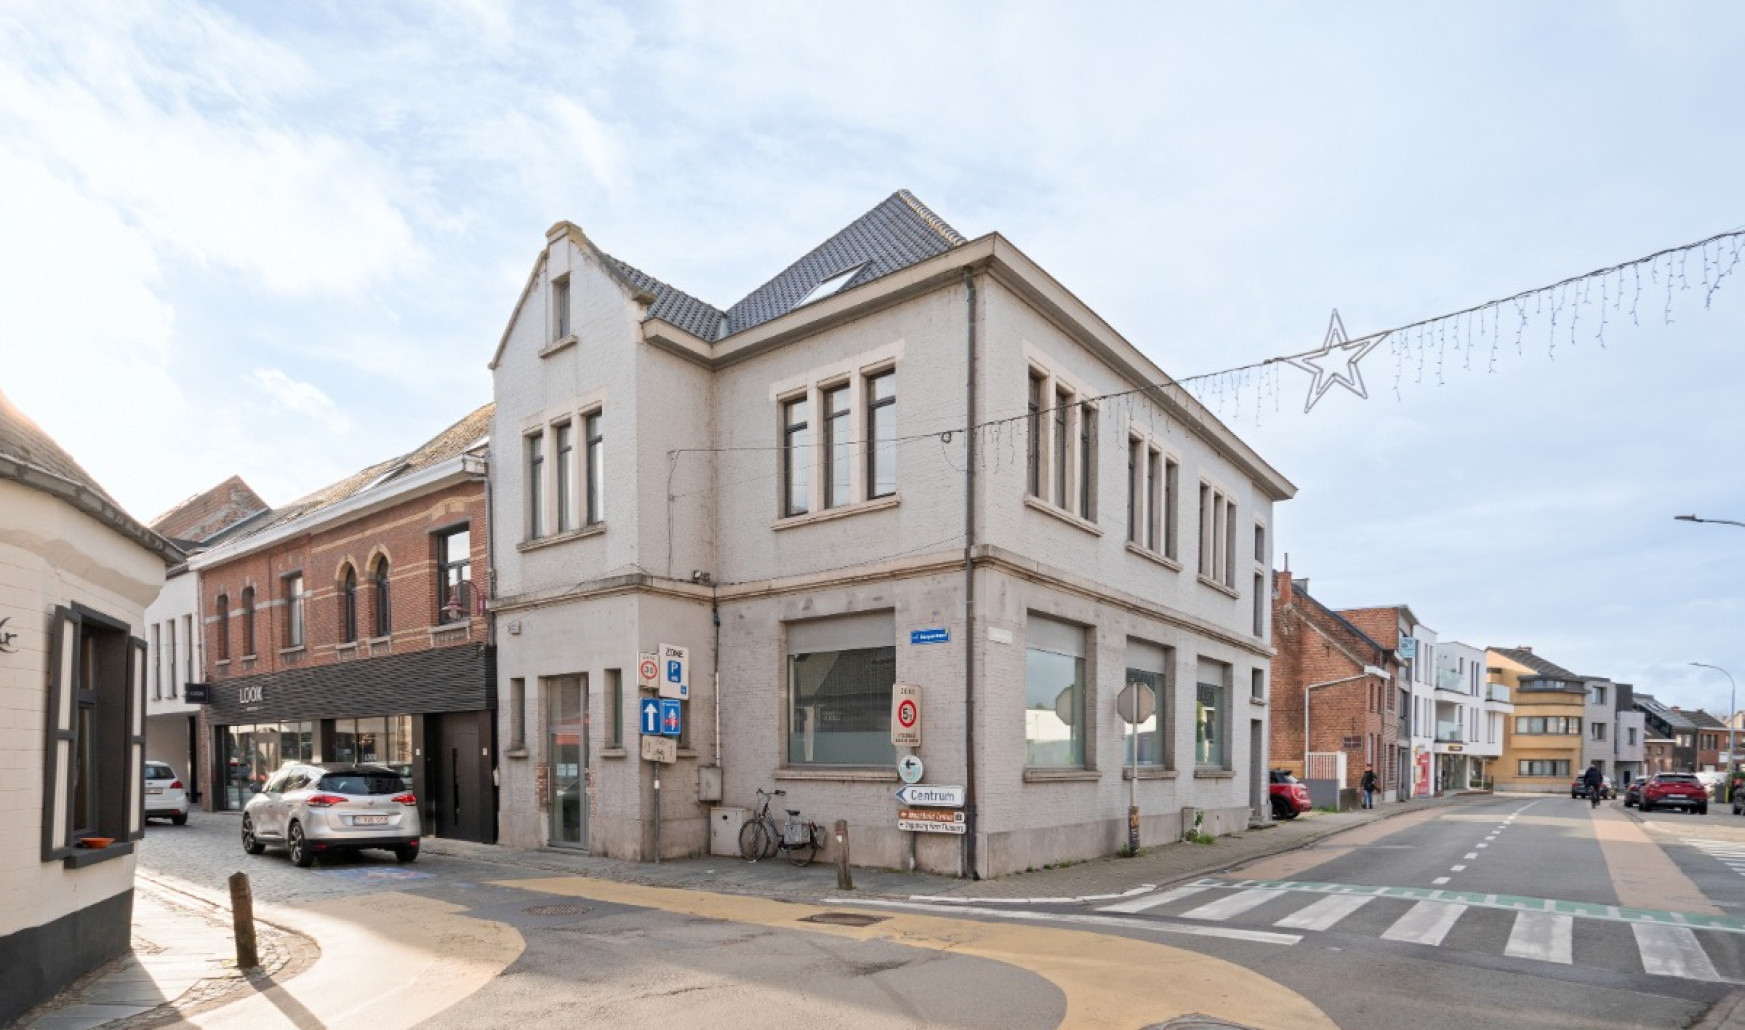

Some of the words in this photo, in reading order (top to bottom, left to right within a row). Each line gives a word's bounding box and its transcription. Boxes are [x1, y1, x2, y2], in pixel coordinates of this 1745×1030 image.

[665, 647, 683, 658] ZONE
[240, 686, 263, 703] LOOK
[911, 789, 955, 802] Centrum
